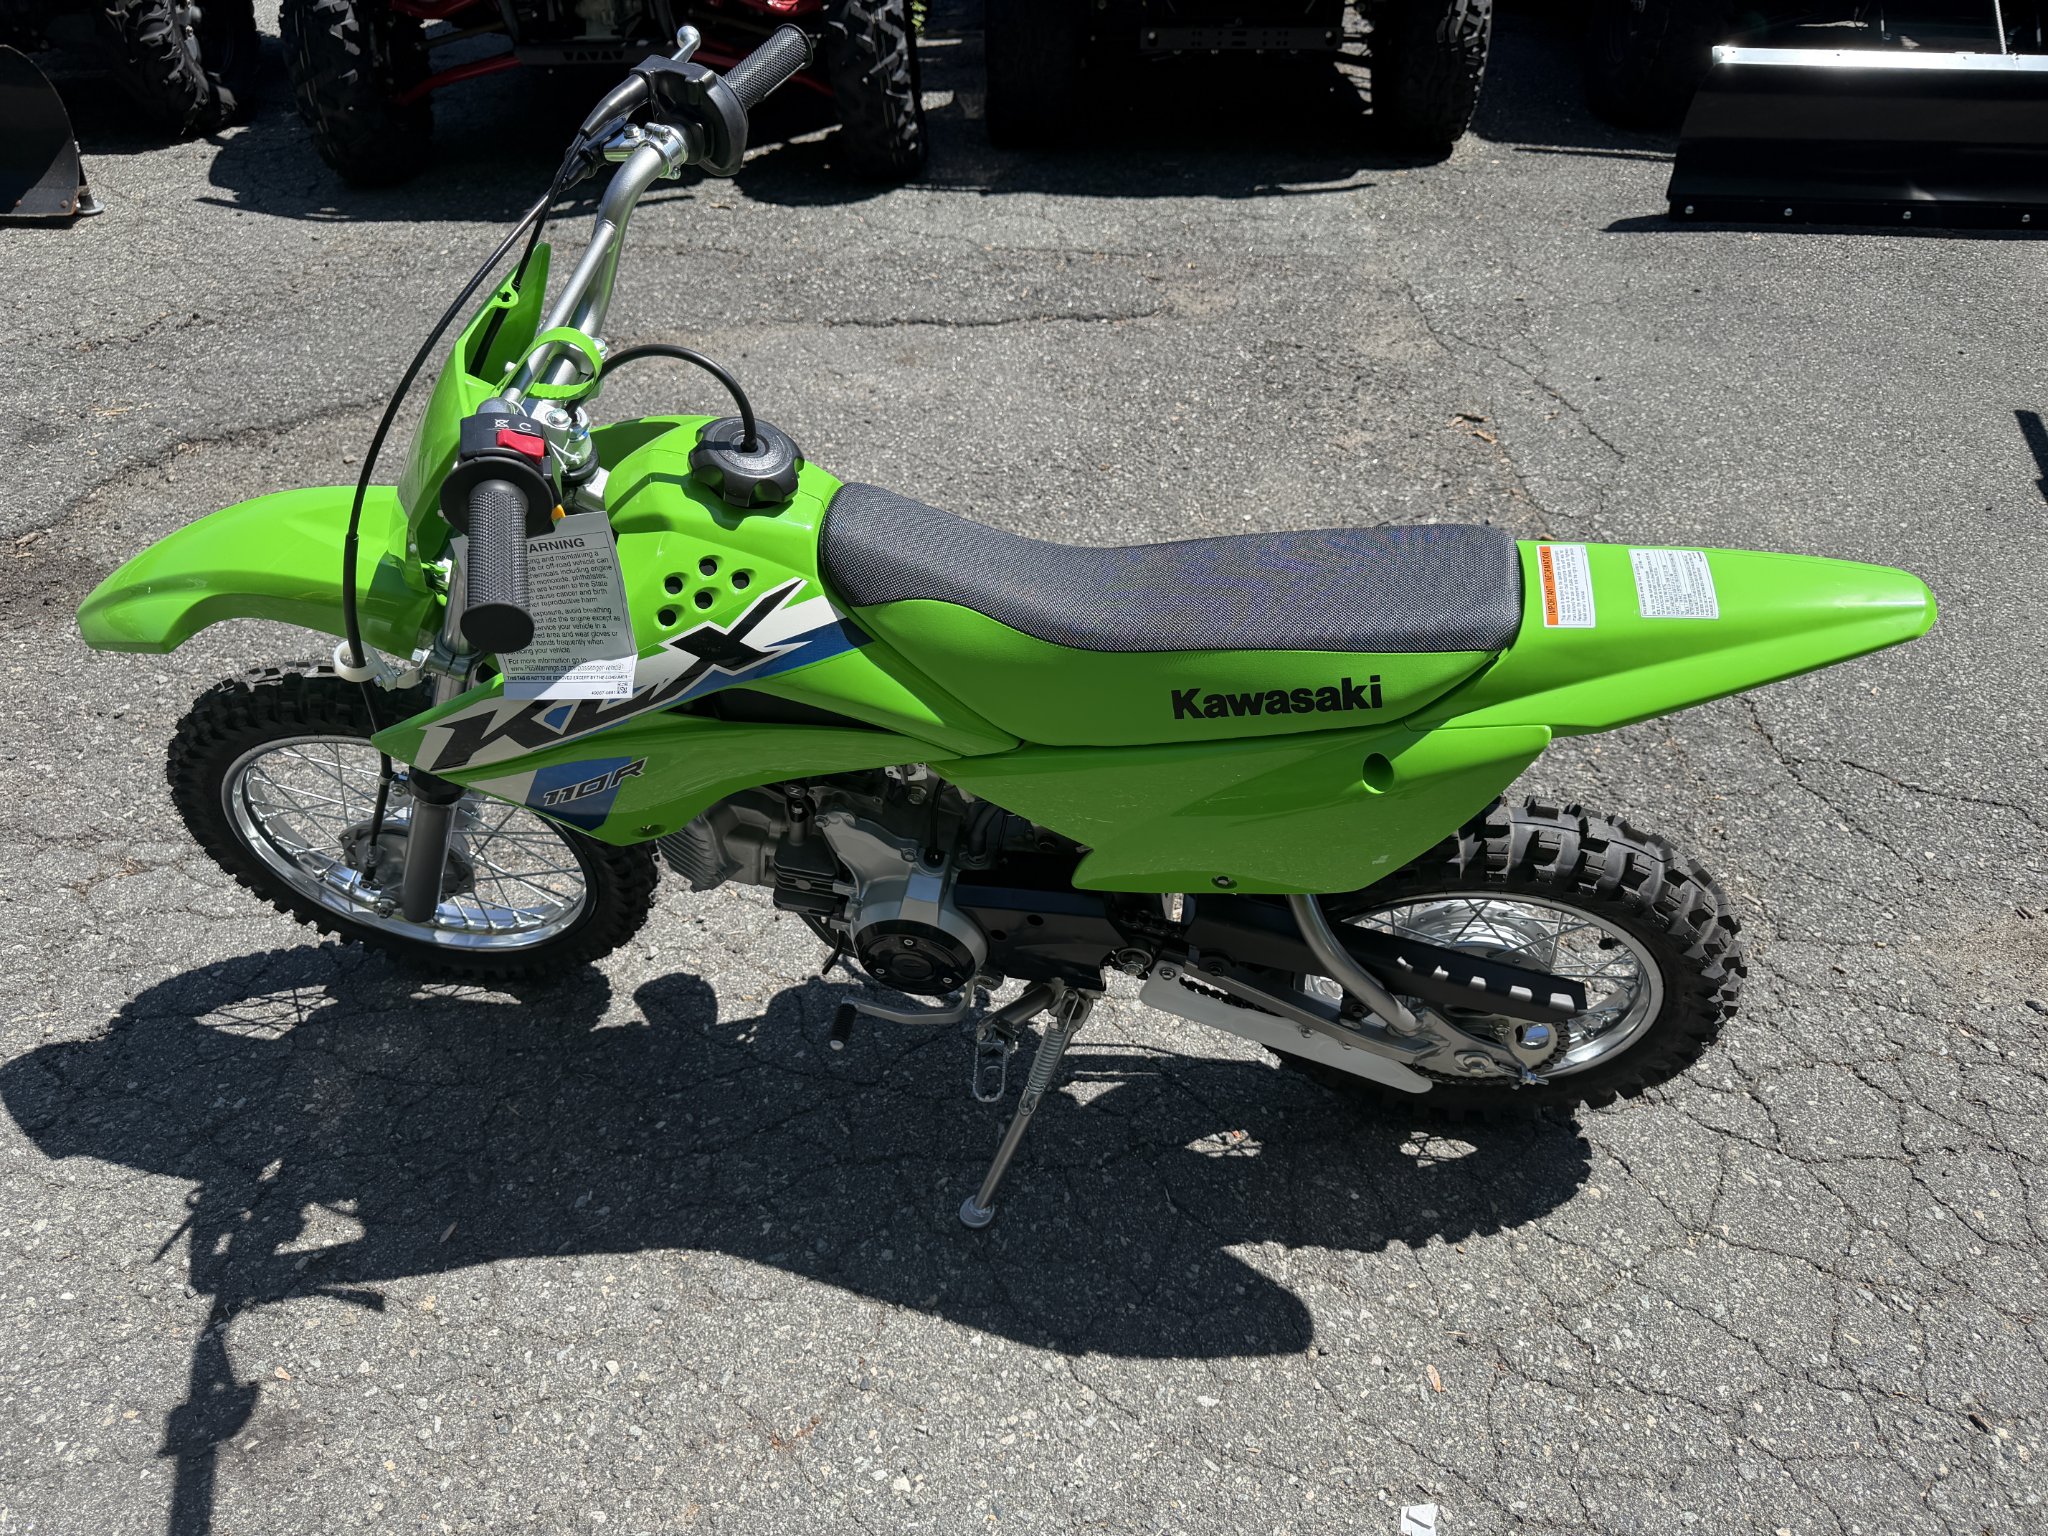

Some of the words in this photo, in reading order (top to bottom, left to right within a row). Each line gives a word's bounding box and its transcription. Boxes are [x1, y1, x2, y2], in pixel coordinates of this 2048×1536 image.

[529, 538, 585, 553] ARNING
[573, 558, 596, 566] vehicle
[560, 566, 590, 574] including
[591, 564, 613, 572] engine
[572, 622, 594, 630] vehicle
[534, 647, 548, 655] your
[537, 656, 572, 664] information
[1171, 674, 1383, 720] Kawasaki
[543, 756, 649, 807] 110R
